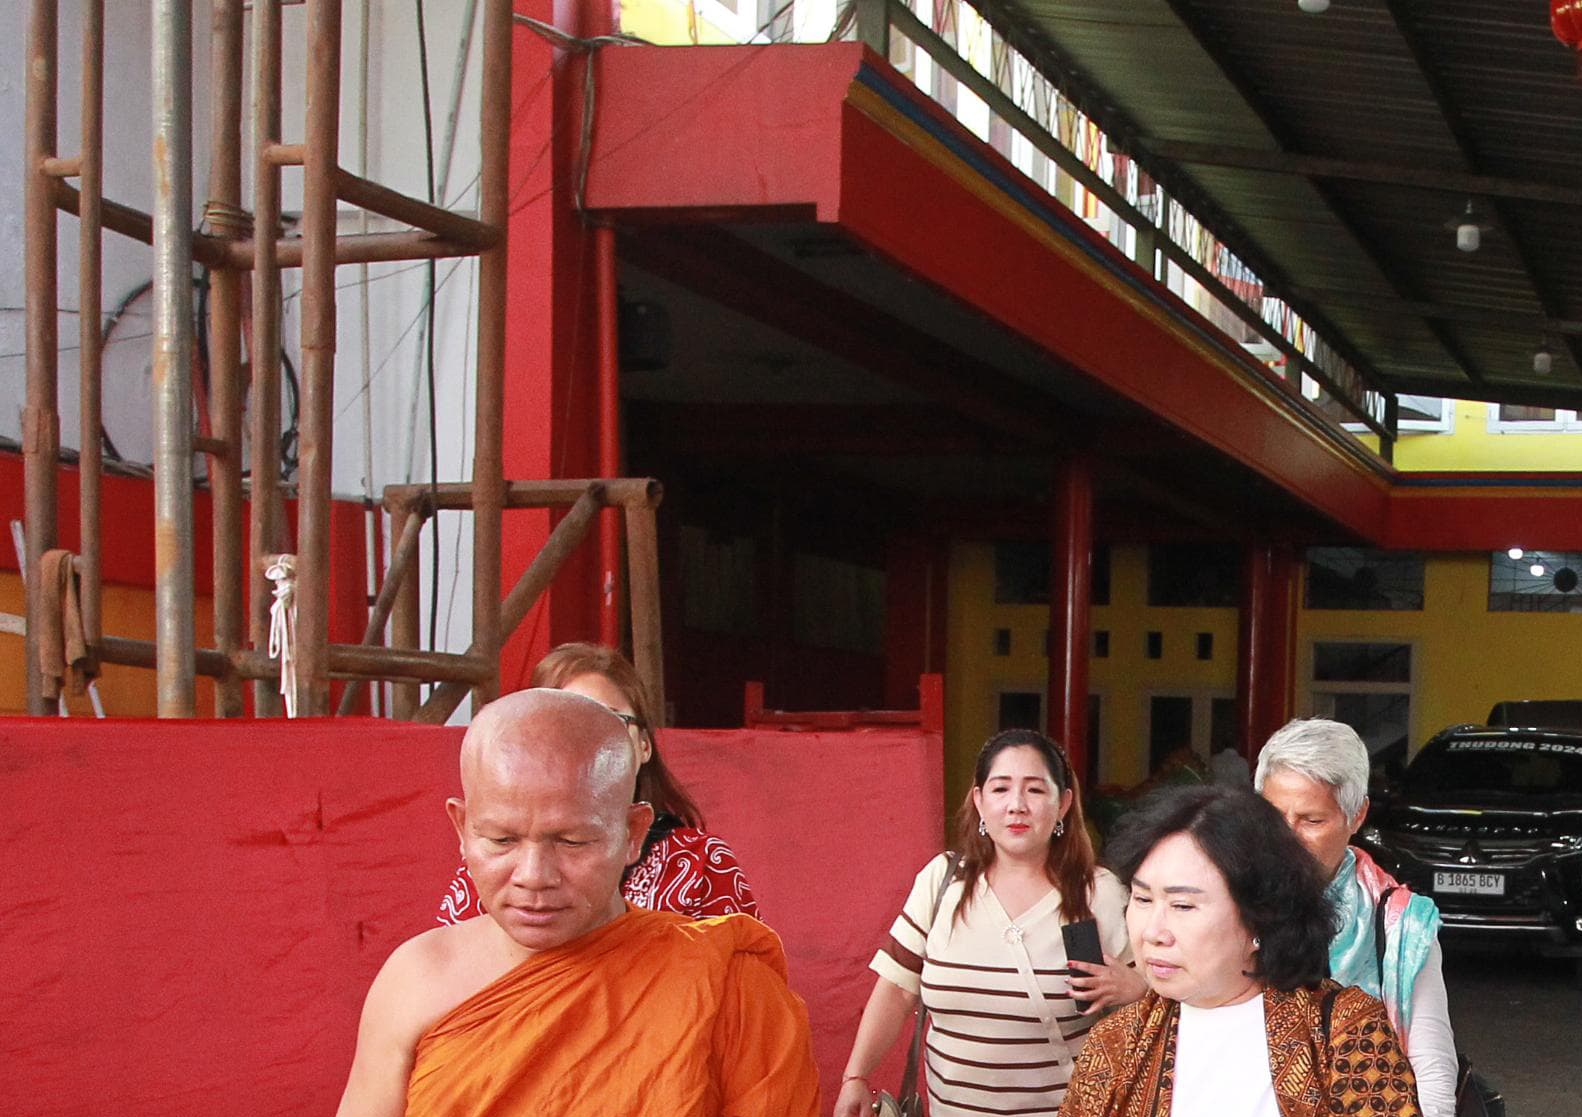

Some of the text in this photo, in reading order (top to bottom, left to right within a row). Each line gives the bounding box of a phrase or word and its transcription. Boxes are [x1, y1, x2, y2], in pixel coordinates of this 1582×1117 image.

[1448, 741, 1535, 750] THUDONG
[1437, 873, 1501, 888] B 1865 BCY
